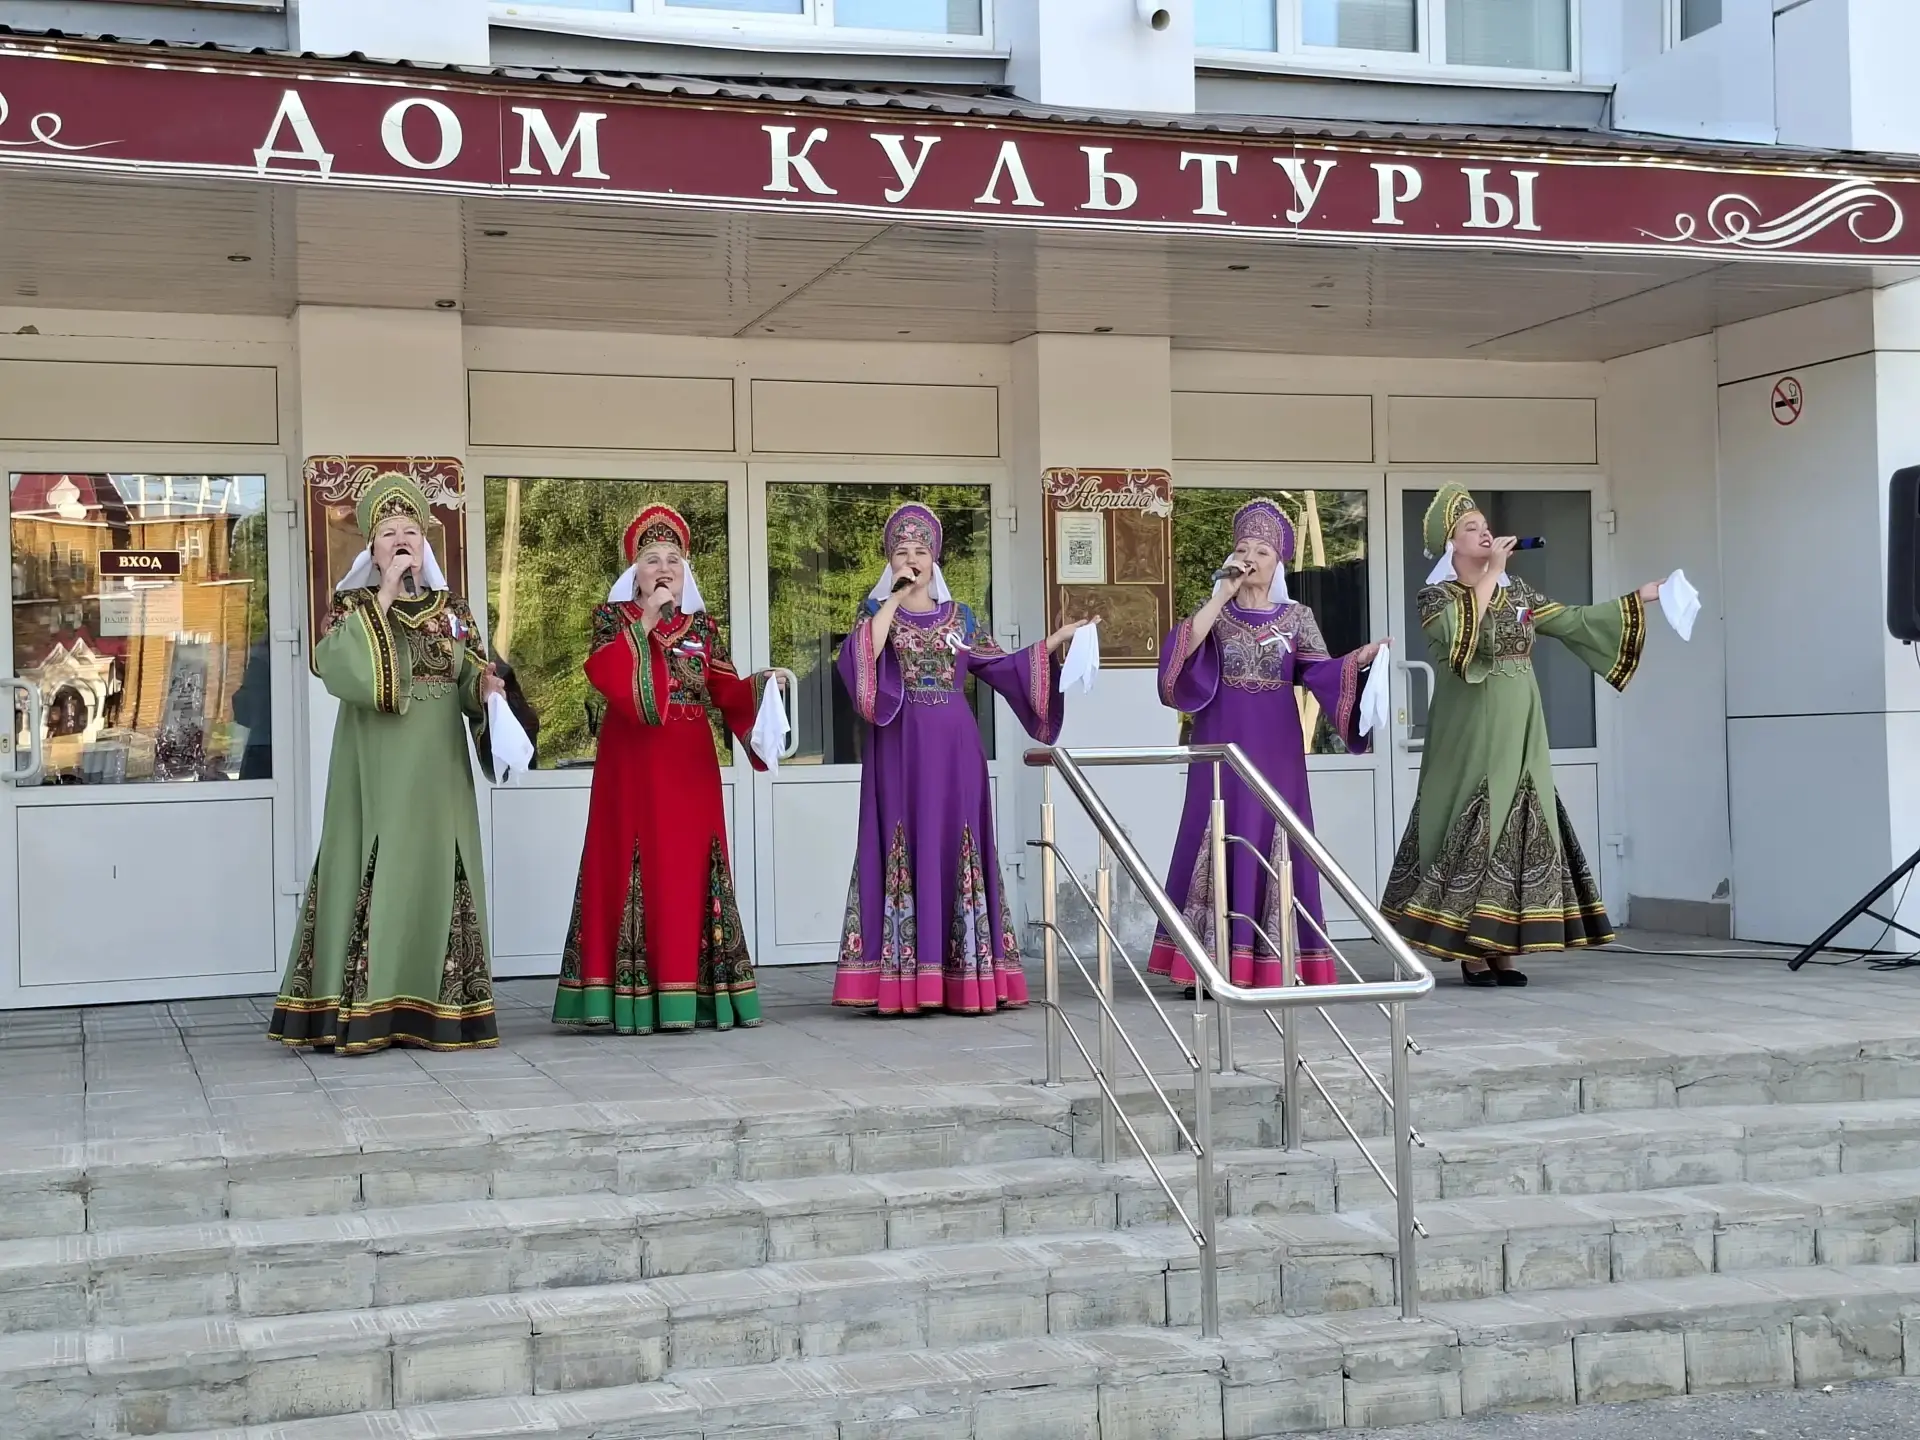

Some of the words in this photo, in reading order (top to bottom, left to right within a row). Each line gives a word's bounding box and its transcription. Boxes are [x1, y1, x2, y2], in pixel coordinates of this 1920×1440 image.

[253, 90, 611, 181] ДОМ
[761, 124, 1542, 232] КУЛЬТУРЫ
[1059, 477, 1152, 512] Афиша
[118, 556, 162, 570] ВХОД
